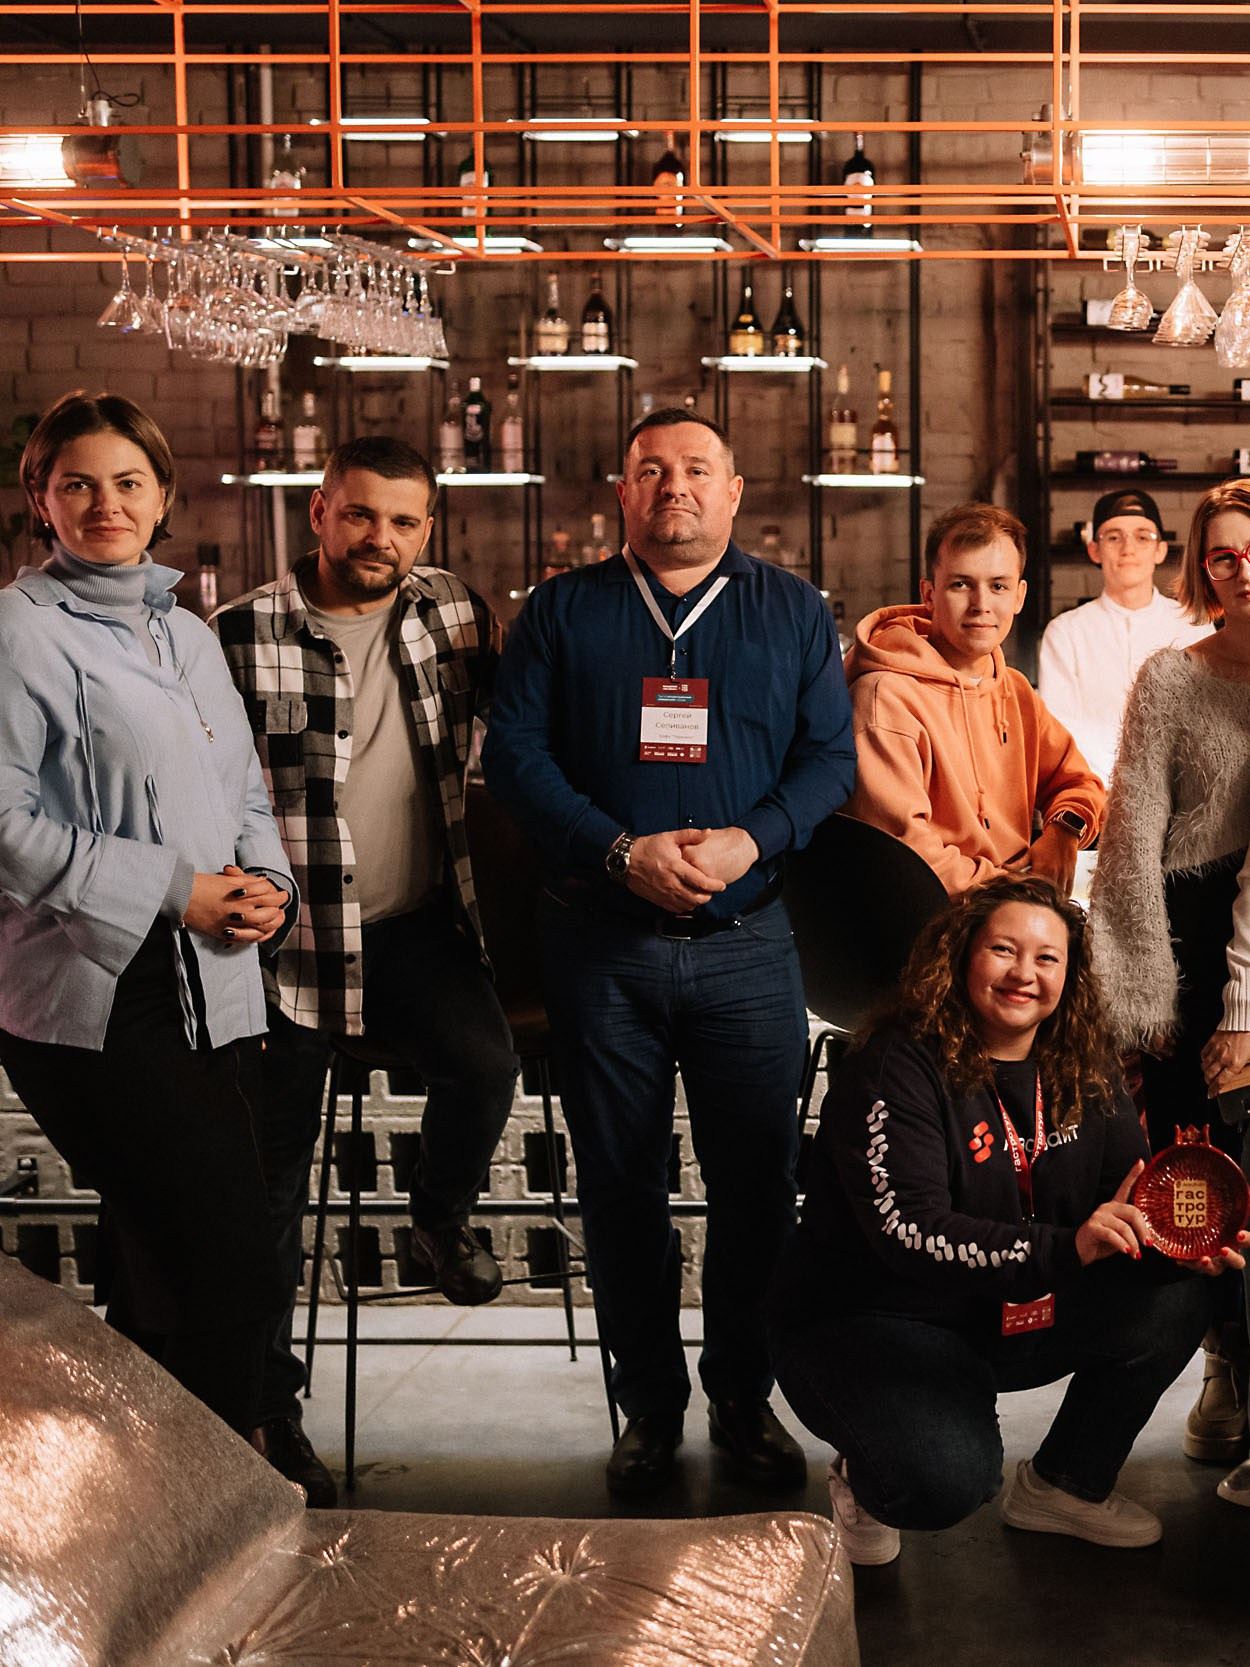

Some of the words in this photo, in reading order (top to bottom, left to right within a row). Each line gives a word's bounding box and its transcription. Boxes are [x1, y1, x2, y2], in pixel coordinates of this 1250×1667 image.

[663, 711, 692, 719] Сергей
[655, 721, 699, 730] Селиванов
[1176, 1190, 1205, 1200] гас
[1175, 1202, 1206, 1213] тро
[1175, 1214, 1206, 1226] тур
